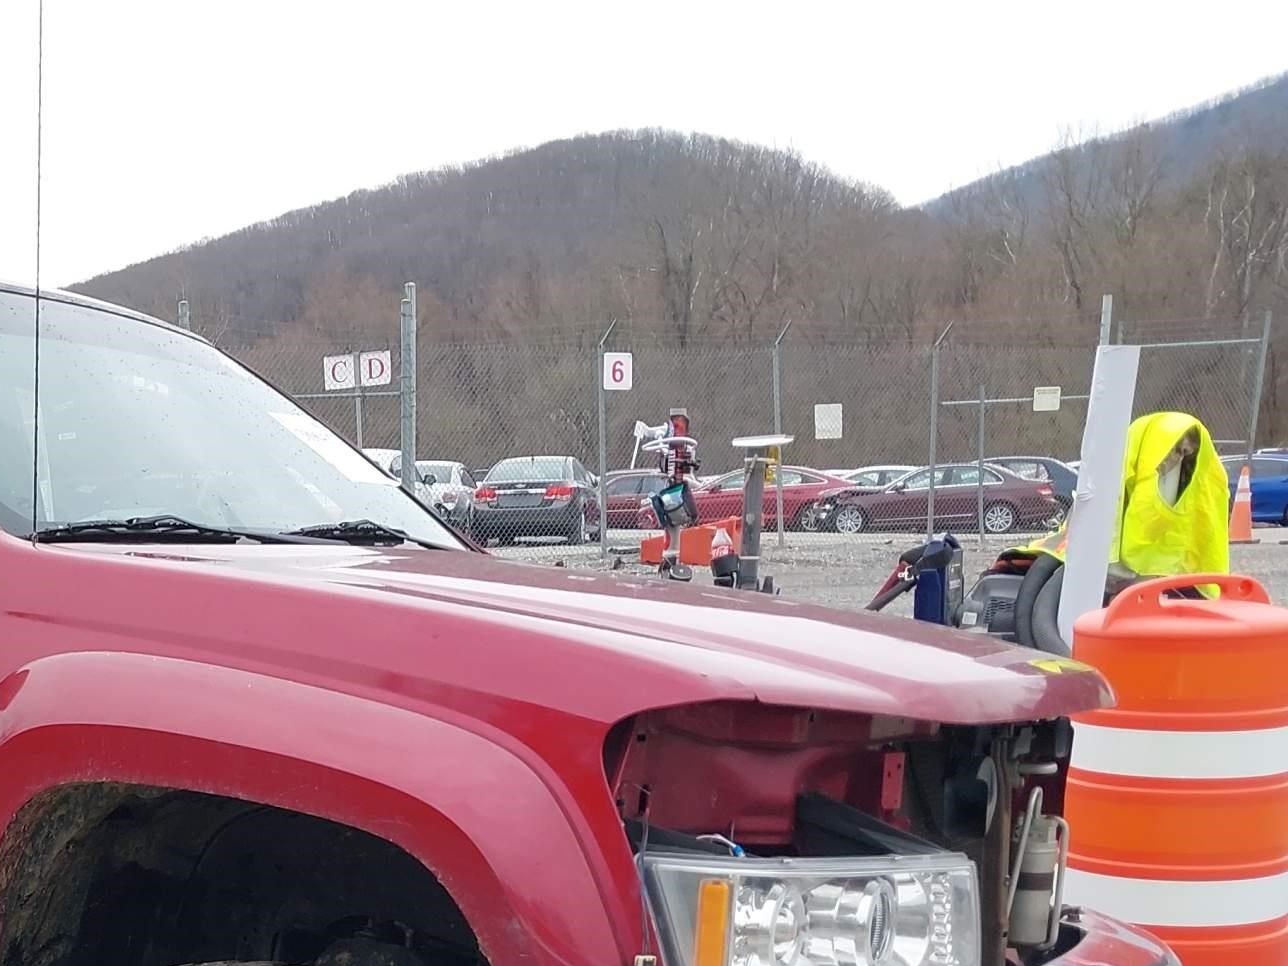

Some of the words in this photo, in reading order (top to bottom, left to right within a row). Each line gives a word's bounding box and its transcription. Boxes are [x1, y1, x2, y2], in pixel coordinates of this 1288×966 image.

[332, 361, 348, 383] C
[368, 358, 385, 380] D
[612, 360, 624, 383] 6
